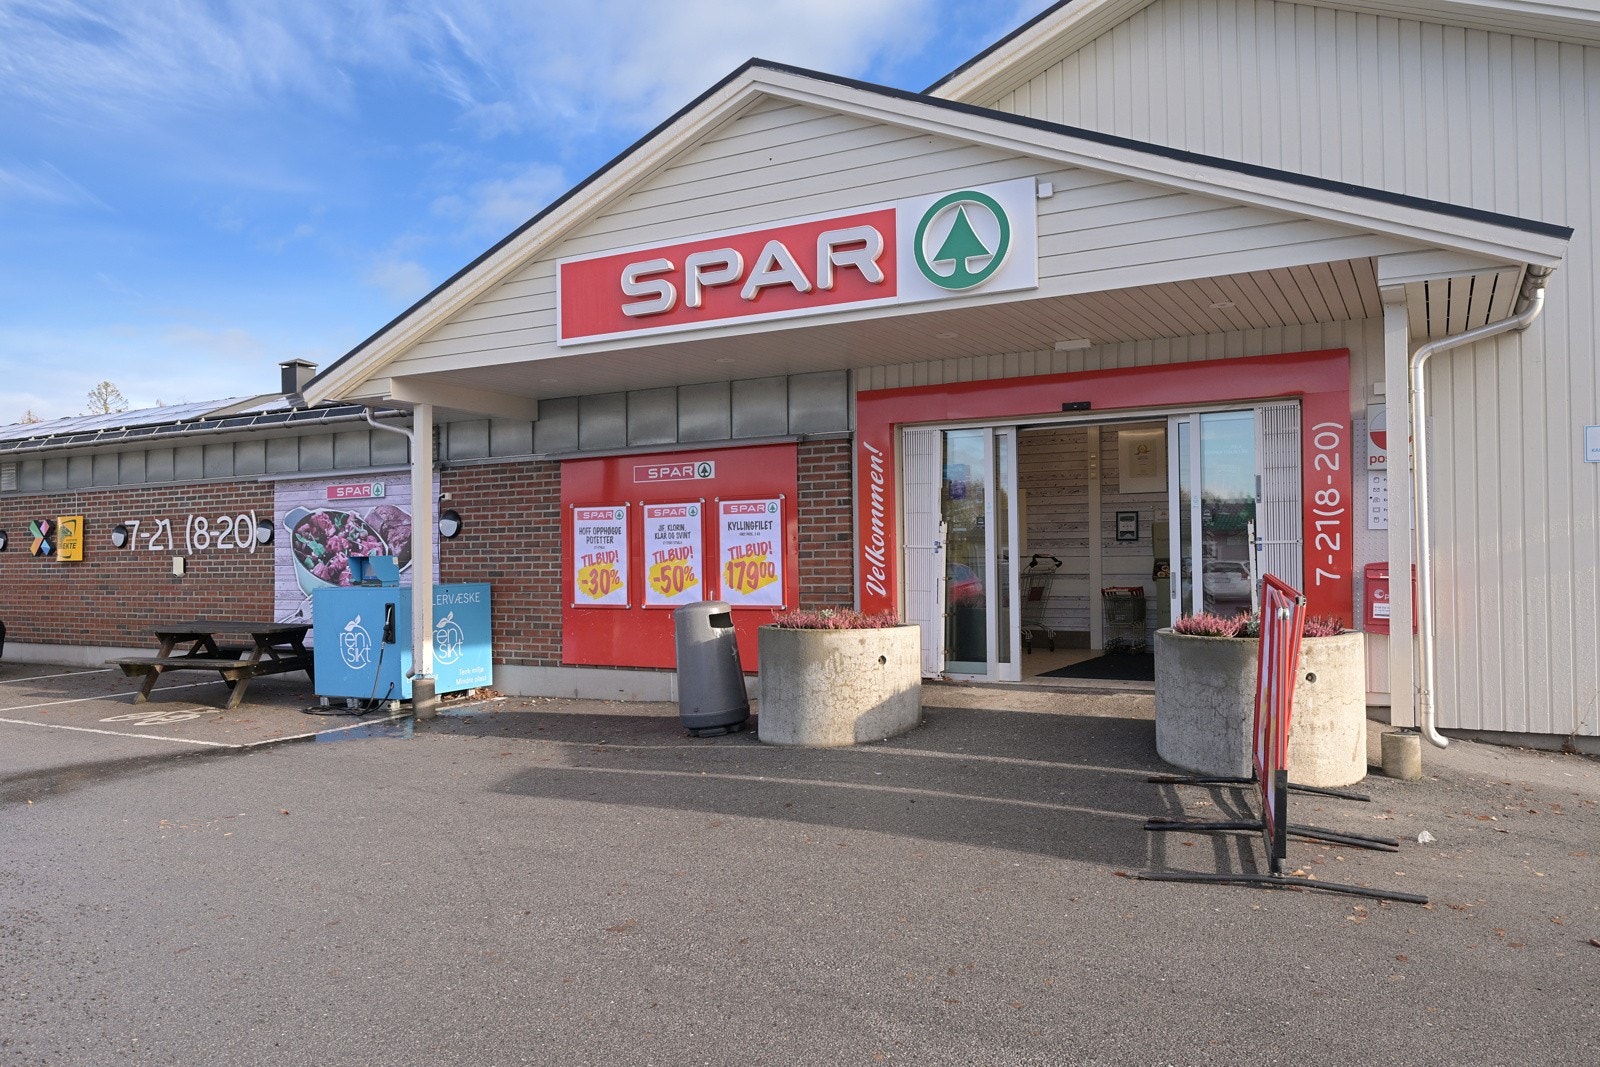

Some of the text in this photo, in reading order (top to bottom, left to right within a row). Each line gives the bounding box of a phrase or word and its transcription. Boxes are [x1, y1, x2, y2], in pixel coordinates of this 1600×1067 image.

[620, 224, 885, 318] SPAR
[648, 465, 693, 479] SPAR
[336, 484, 371, 497] SPAR
[583, 511, 613, 519] SPAR
[654, 508, 686, 517] SPAR
[730, 504, 765, 513] SPAR
[727, 520, 773, 532] KYLLINGFILET
[862, 440, 887, 597] Velkommen!
[124, 509, 257, 555] 7-21 (8-20)
[578, 526, 592, 535] HOFF
[654, 532, 667, 540] KLAR
[668, 532, 675, 540] OG
[586, 535, 614, 545] POTETTER
[652, 545, 694, 564] TILBUD!
[727, 541, 773, 561] TILBUD!
[581, 550, 619, 568] TILBUD!
[581, 568, 621, 595] -30%
[653, 565, 695, 593] -50%
[339, 632, 366, 648] ren
